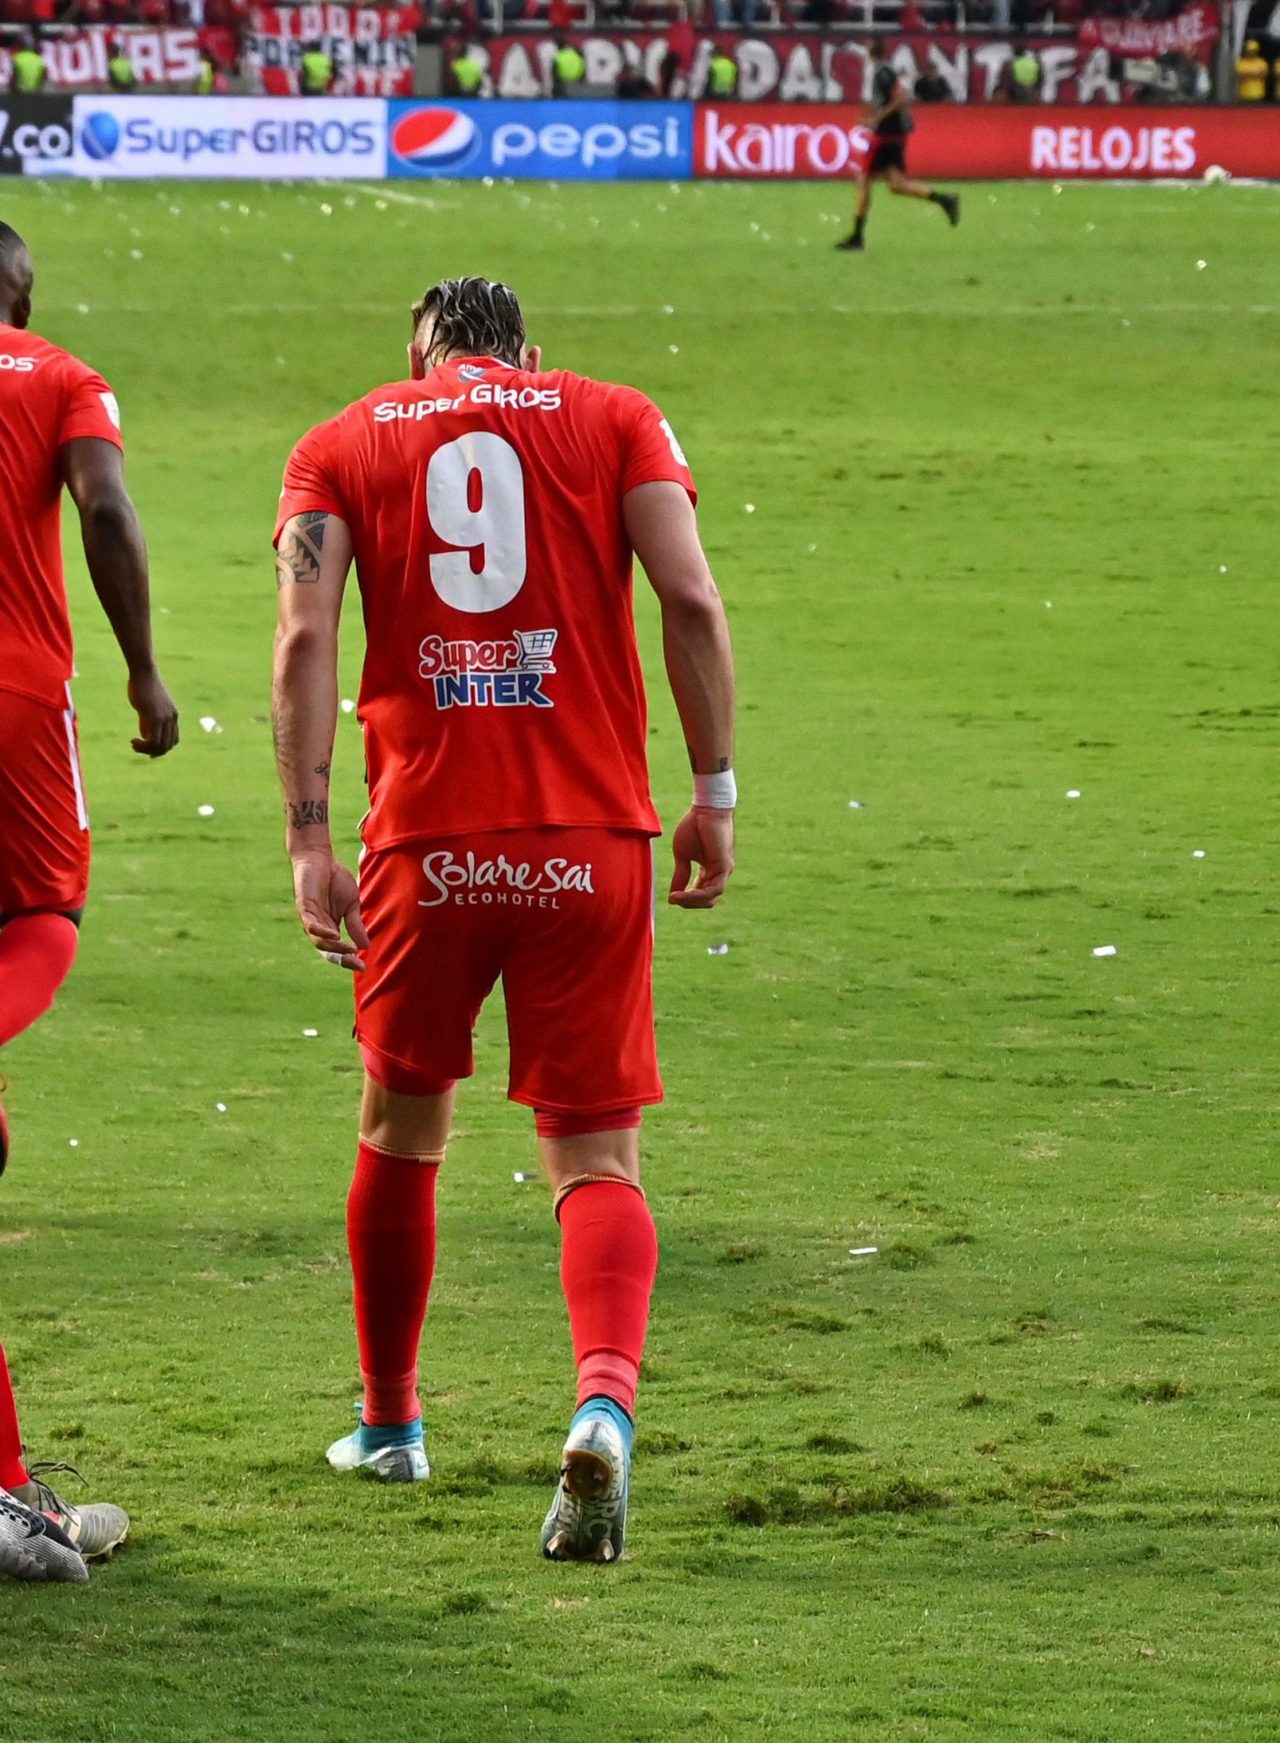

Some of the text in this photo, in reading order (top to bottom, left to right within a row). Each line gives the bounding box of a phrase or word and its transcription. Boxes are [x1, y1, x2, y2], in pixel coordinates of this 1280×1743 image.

[126, 117, 375, 161] SuperGIROS
[491, 116, 679, 167] pepsi
[1030, 126, 1197, 170] RELOJES
[426, 431, 527, 614] 9
[420, 634, 520, 679] Super
[433, 671, 555, 711] INTER
[538, 858, 595, 893] Sai
[455, 892, 561, 910] ECOHOTEL
